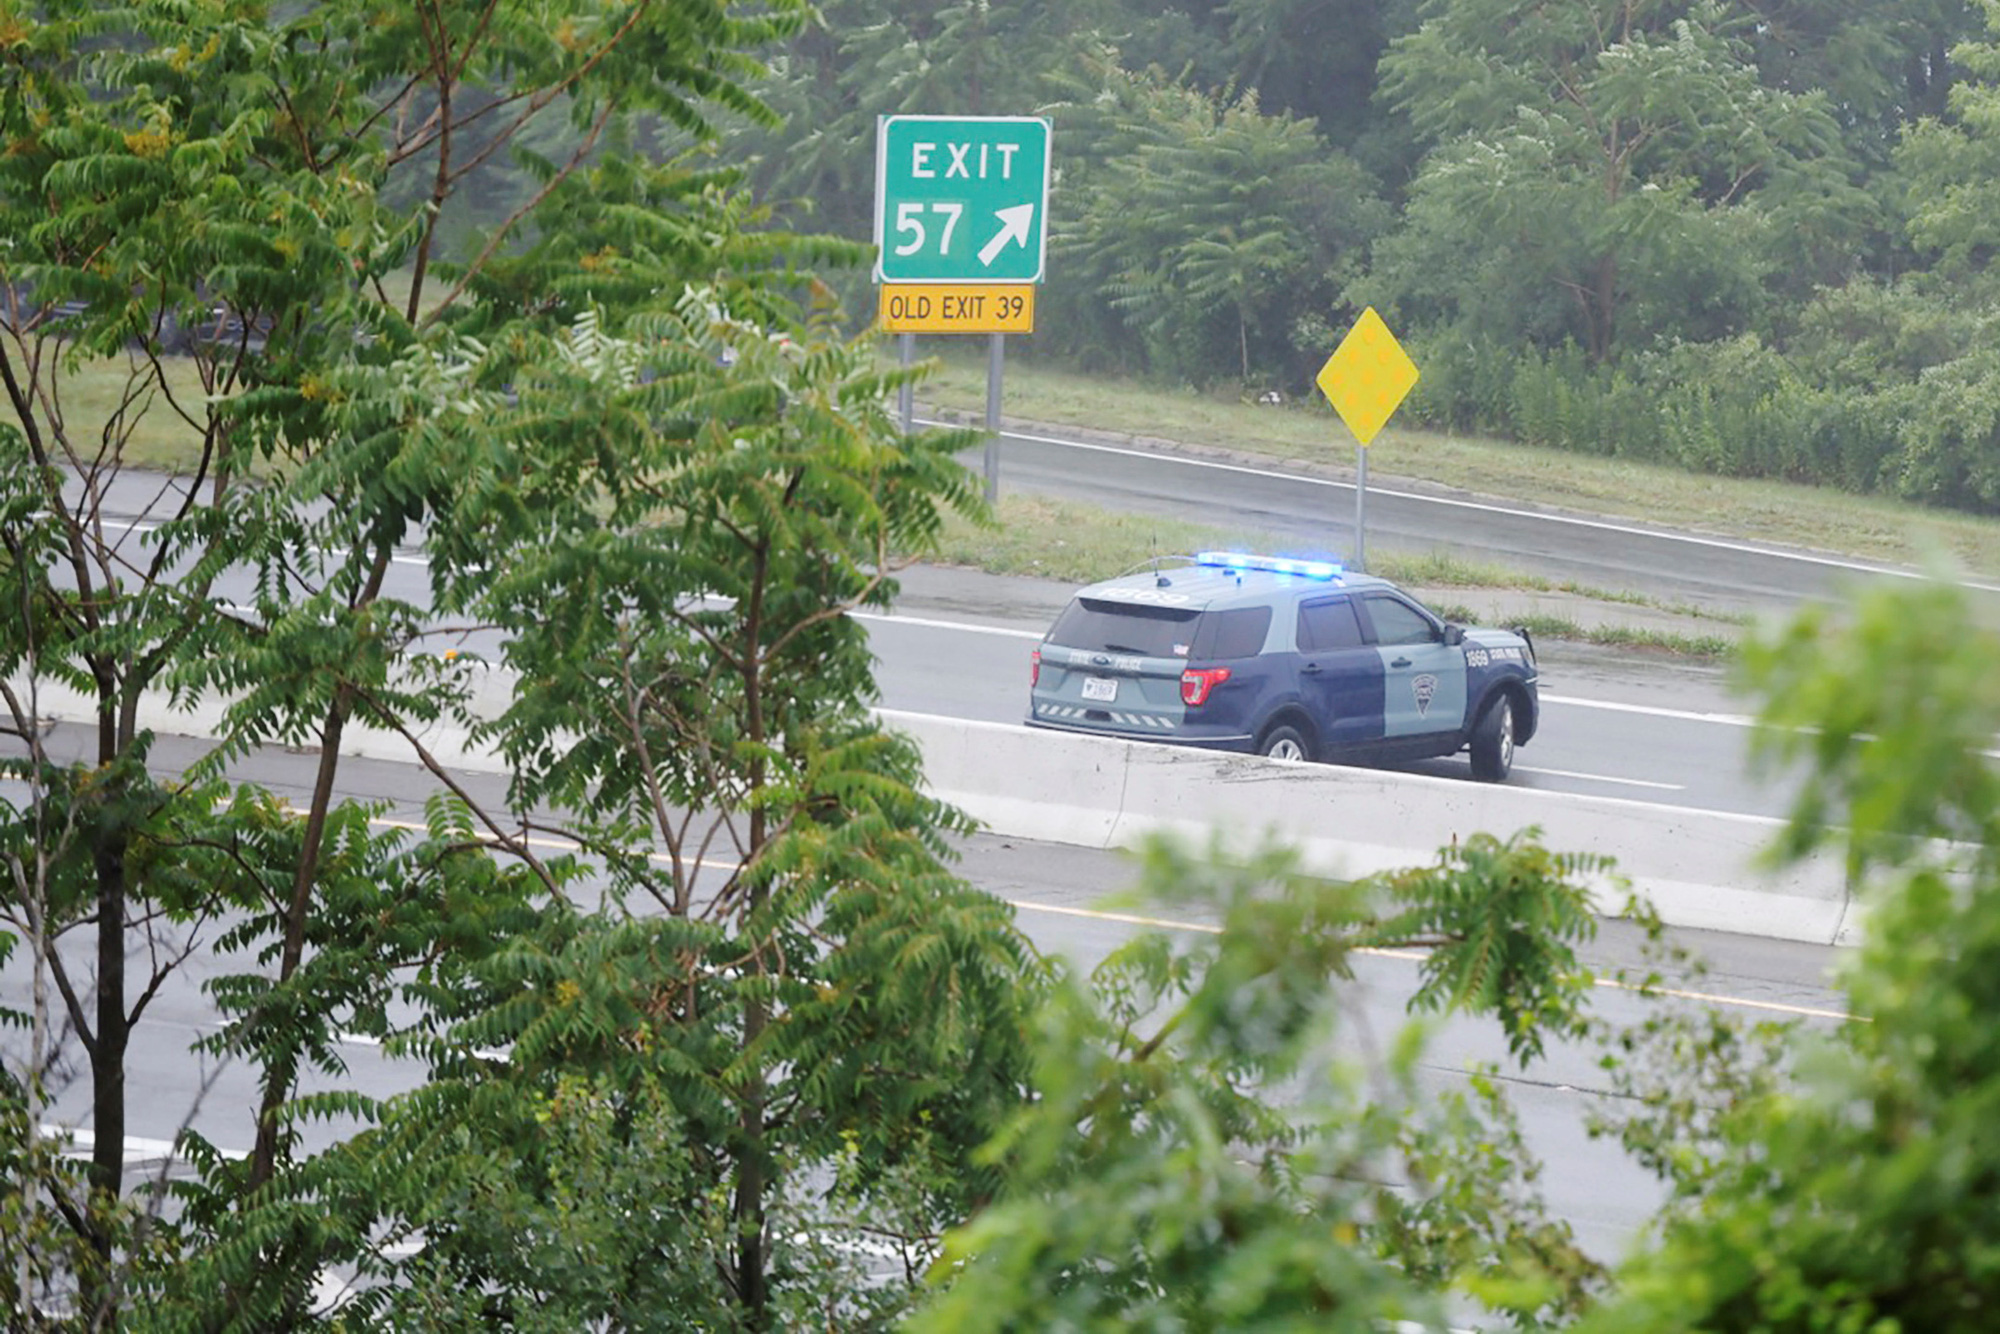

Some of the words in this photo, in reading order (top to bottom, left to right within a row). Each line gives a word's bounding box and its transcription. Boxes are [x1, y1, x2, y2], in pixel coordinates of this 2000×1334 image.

[911, 142, 1020, 179] EXIT
[894, 202, 963, 256] 57
[889, 295, 931, 319] OLD
[942, 295, 986, 319] EXIT
[995, 295, 1024, 319] 39
